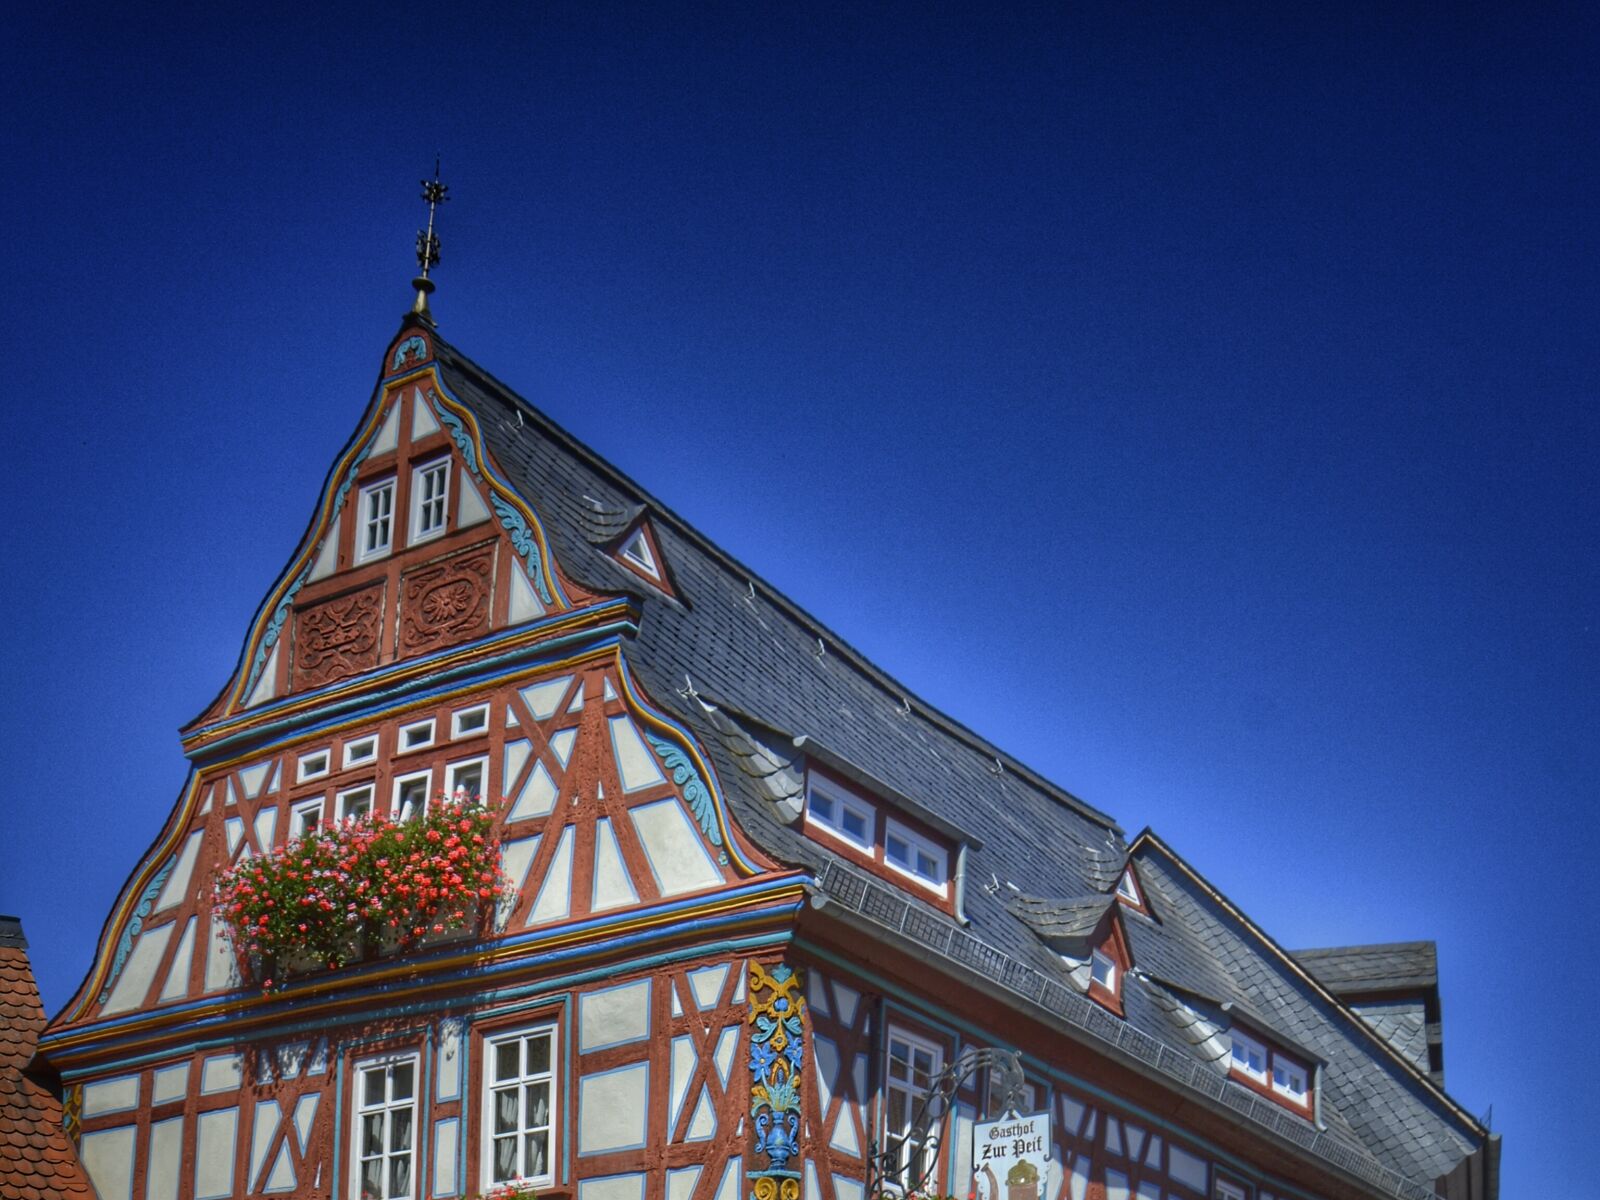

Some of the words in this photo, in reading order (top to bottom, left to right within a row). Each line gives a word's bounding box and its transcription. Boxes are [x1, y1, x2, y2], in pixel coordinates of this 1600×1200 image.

[990, 1121, 1034, 1139] Gasthof
[982, 1144, 1007, 1160] Zur
[1012, 1136, 1042, 1157] Peif
